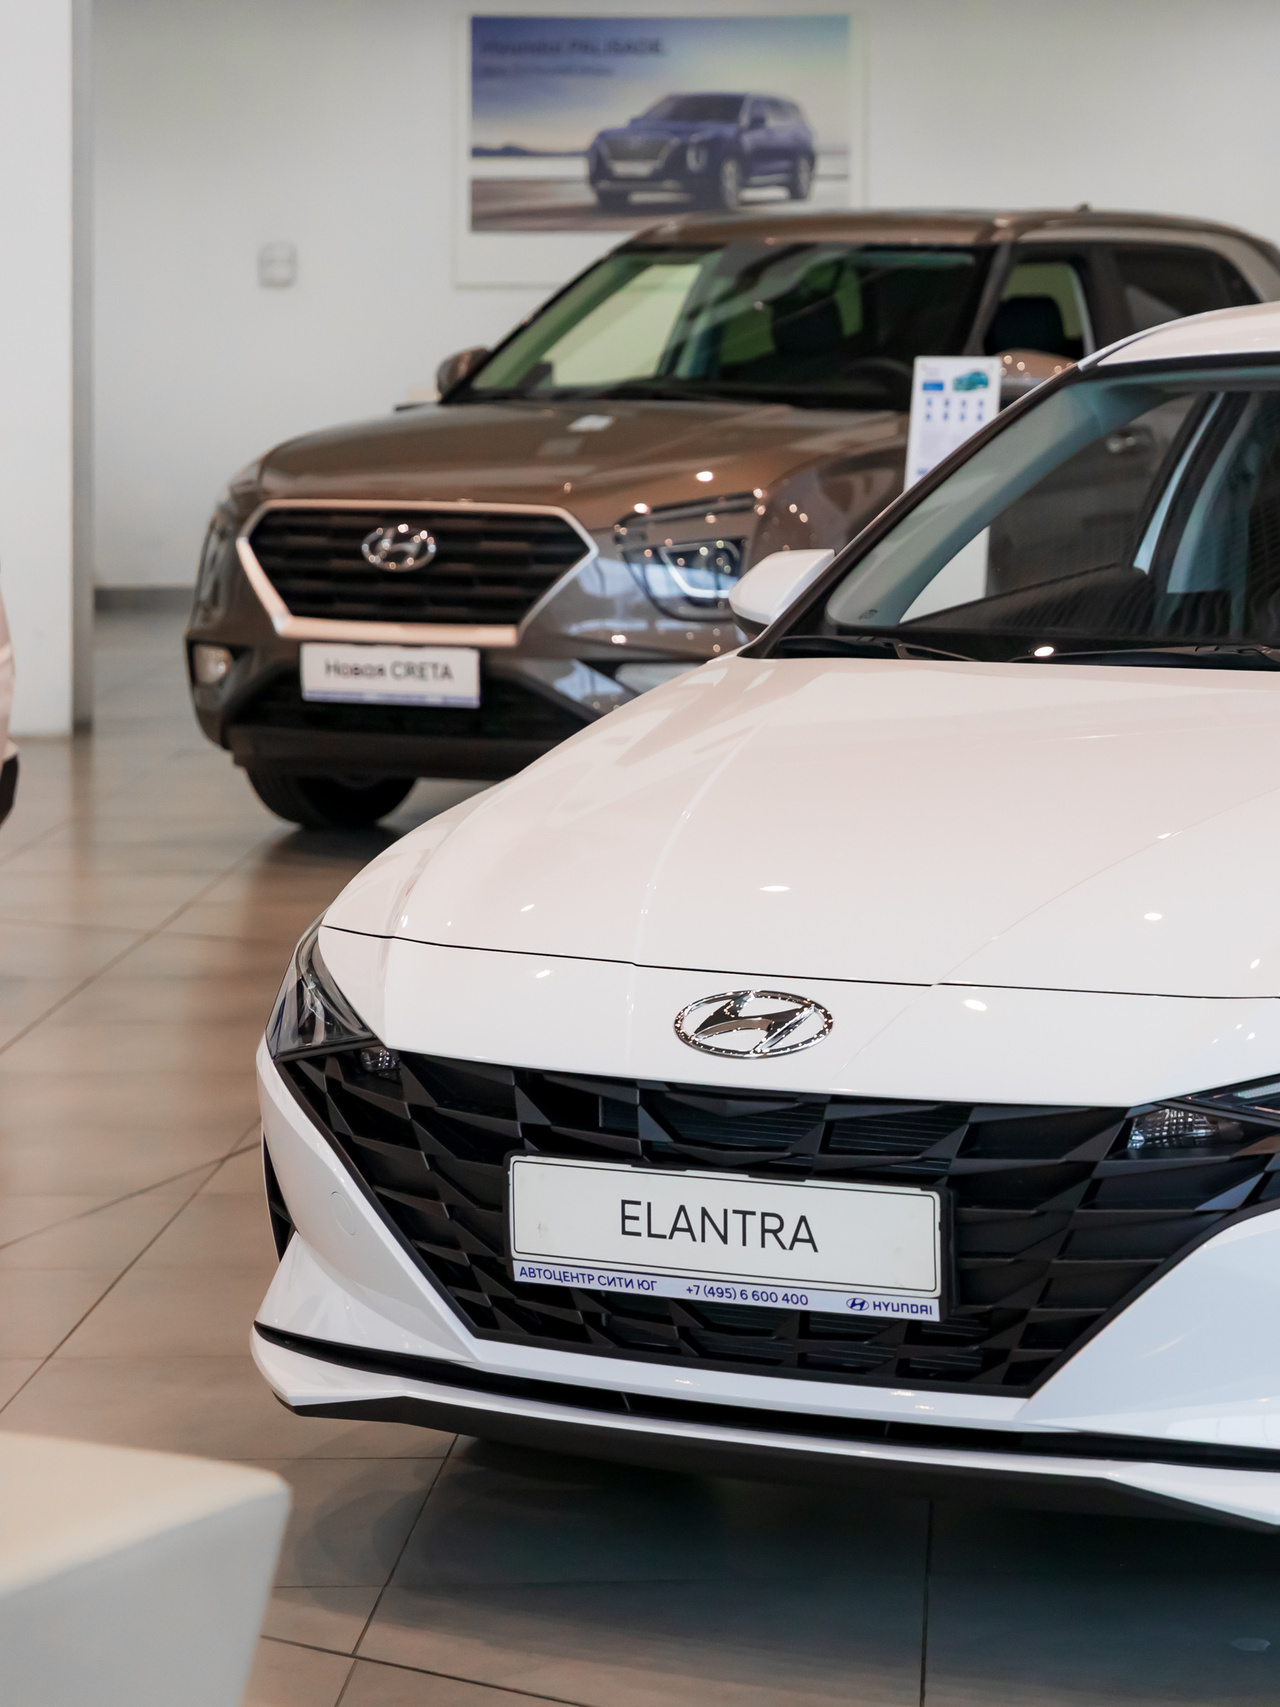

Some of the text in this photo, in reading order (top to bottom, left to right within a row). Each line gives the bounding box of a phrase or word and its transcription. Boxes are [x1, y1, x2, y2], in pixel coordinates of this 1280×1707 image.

[324, 659, 454, 681] Новая CRETA
[620, 1198, 818, 1253] ELANTRA
[519, 1266, 809, 1306] АВТОЦЕНТР СИТИ ЮГ +7 (495) 6 600 400
[872, 1300, 933, 1316] HYUNDAI
